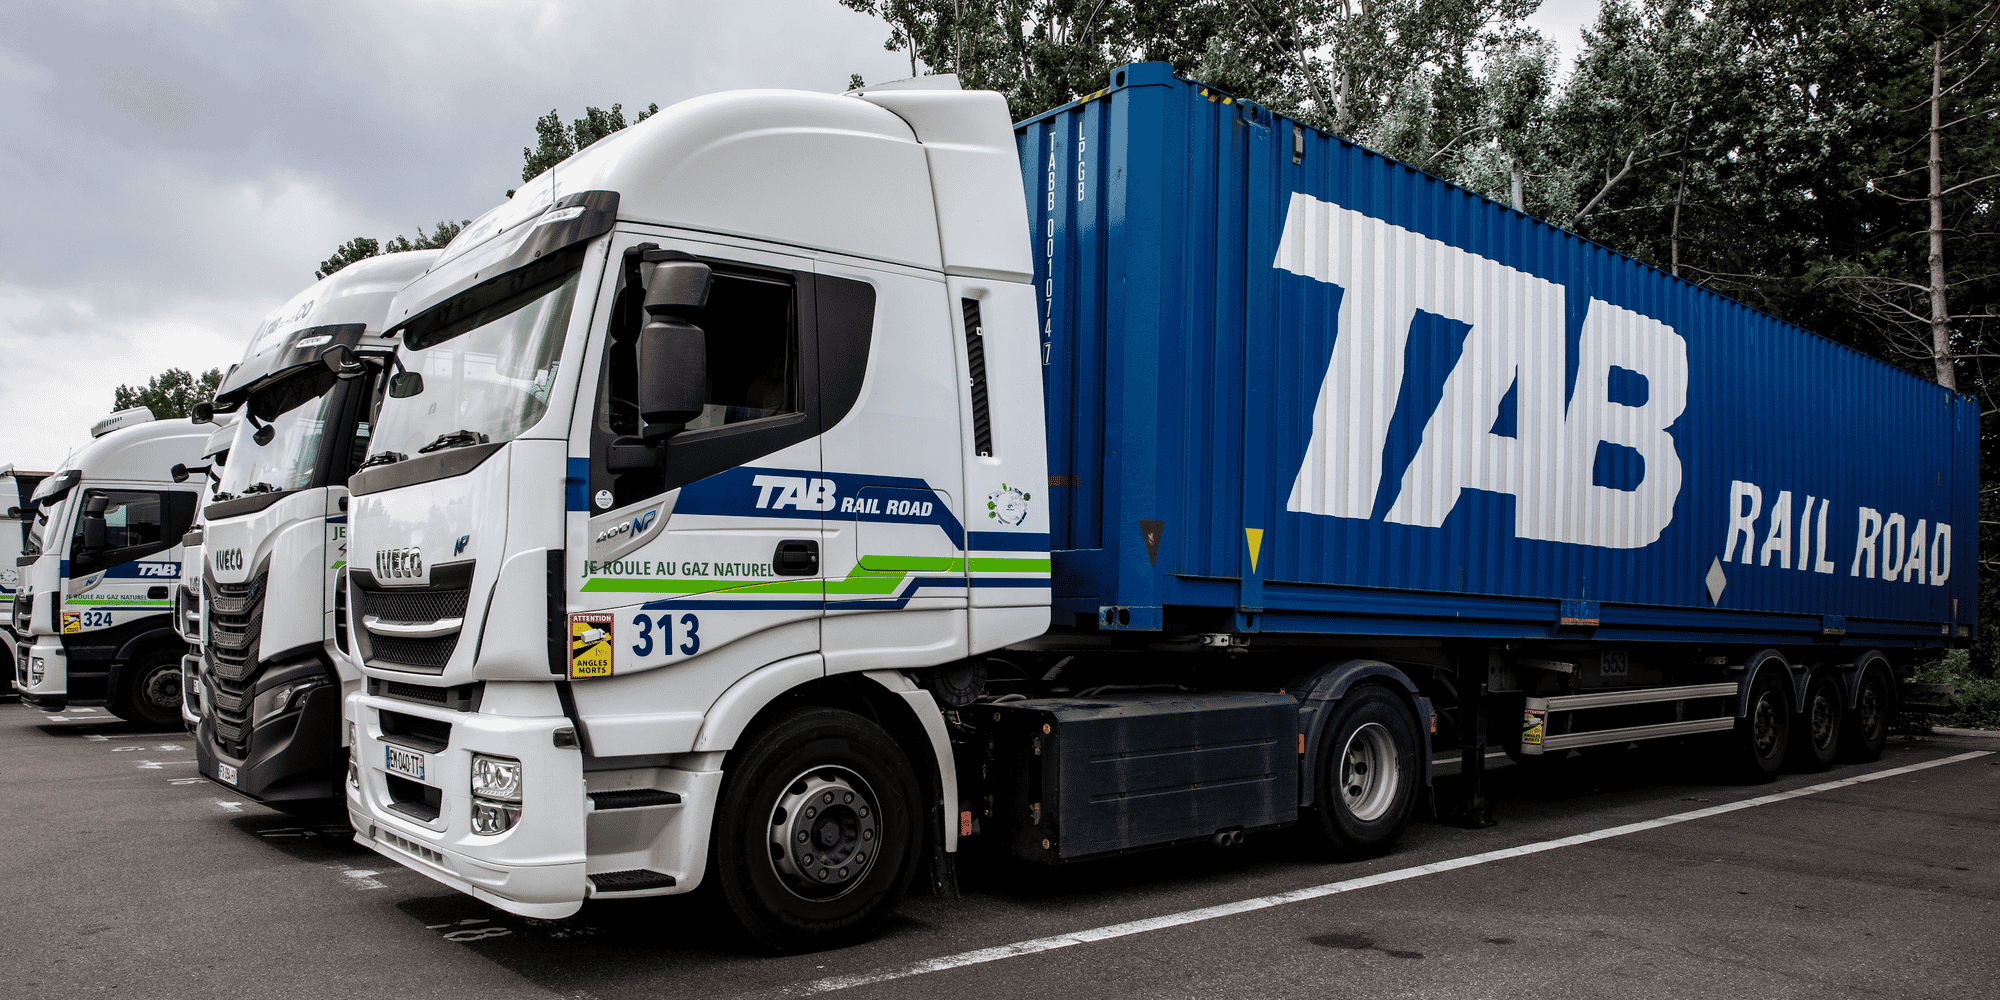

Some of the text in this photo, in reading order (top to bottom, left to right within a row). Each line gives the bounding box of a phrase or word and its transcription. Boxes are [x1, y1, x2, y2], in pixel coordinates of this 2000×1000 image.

[1047, 132, 1057, 212] TABB
[1077, 122, 1086, 201] LPGB
[1272, 191, 1689, 550] TAB
[752, 474, 933, 517] TAB RAIL ROAD
[331, 526, 346, 541] JE
[1722, 479, 1952, 587] RAIL ROAD
[137, 563, 177, 577] TAB
[215, 547, 243, 572] IVECO
[376, 546, 423, 579] IVECO
[581, 560, 774, 579] JE ROULE AU GAZ NATUREL
[83, 612, 113, 627] 324
[632, 613, 701, 657] 313
[577, 659, 608, 667] ANGLES
[1602, 651, 1626, 674] 553
